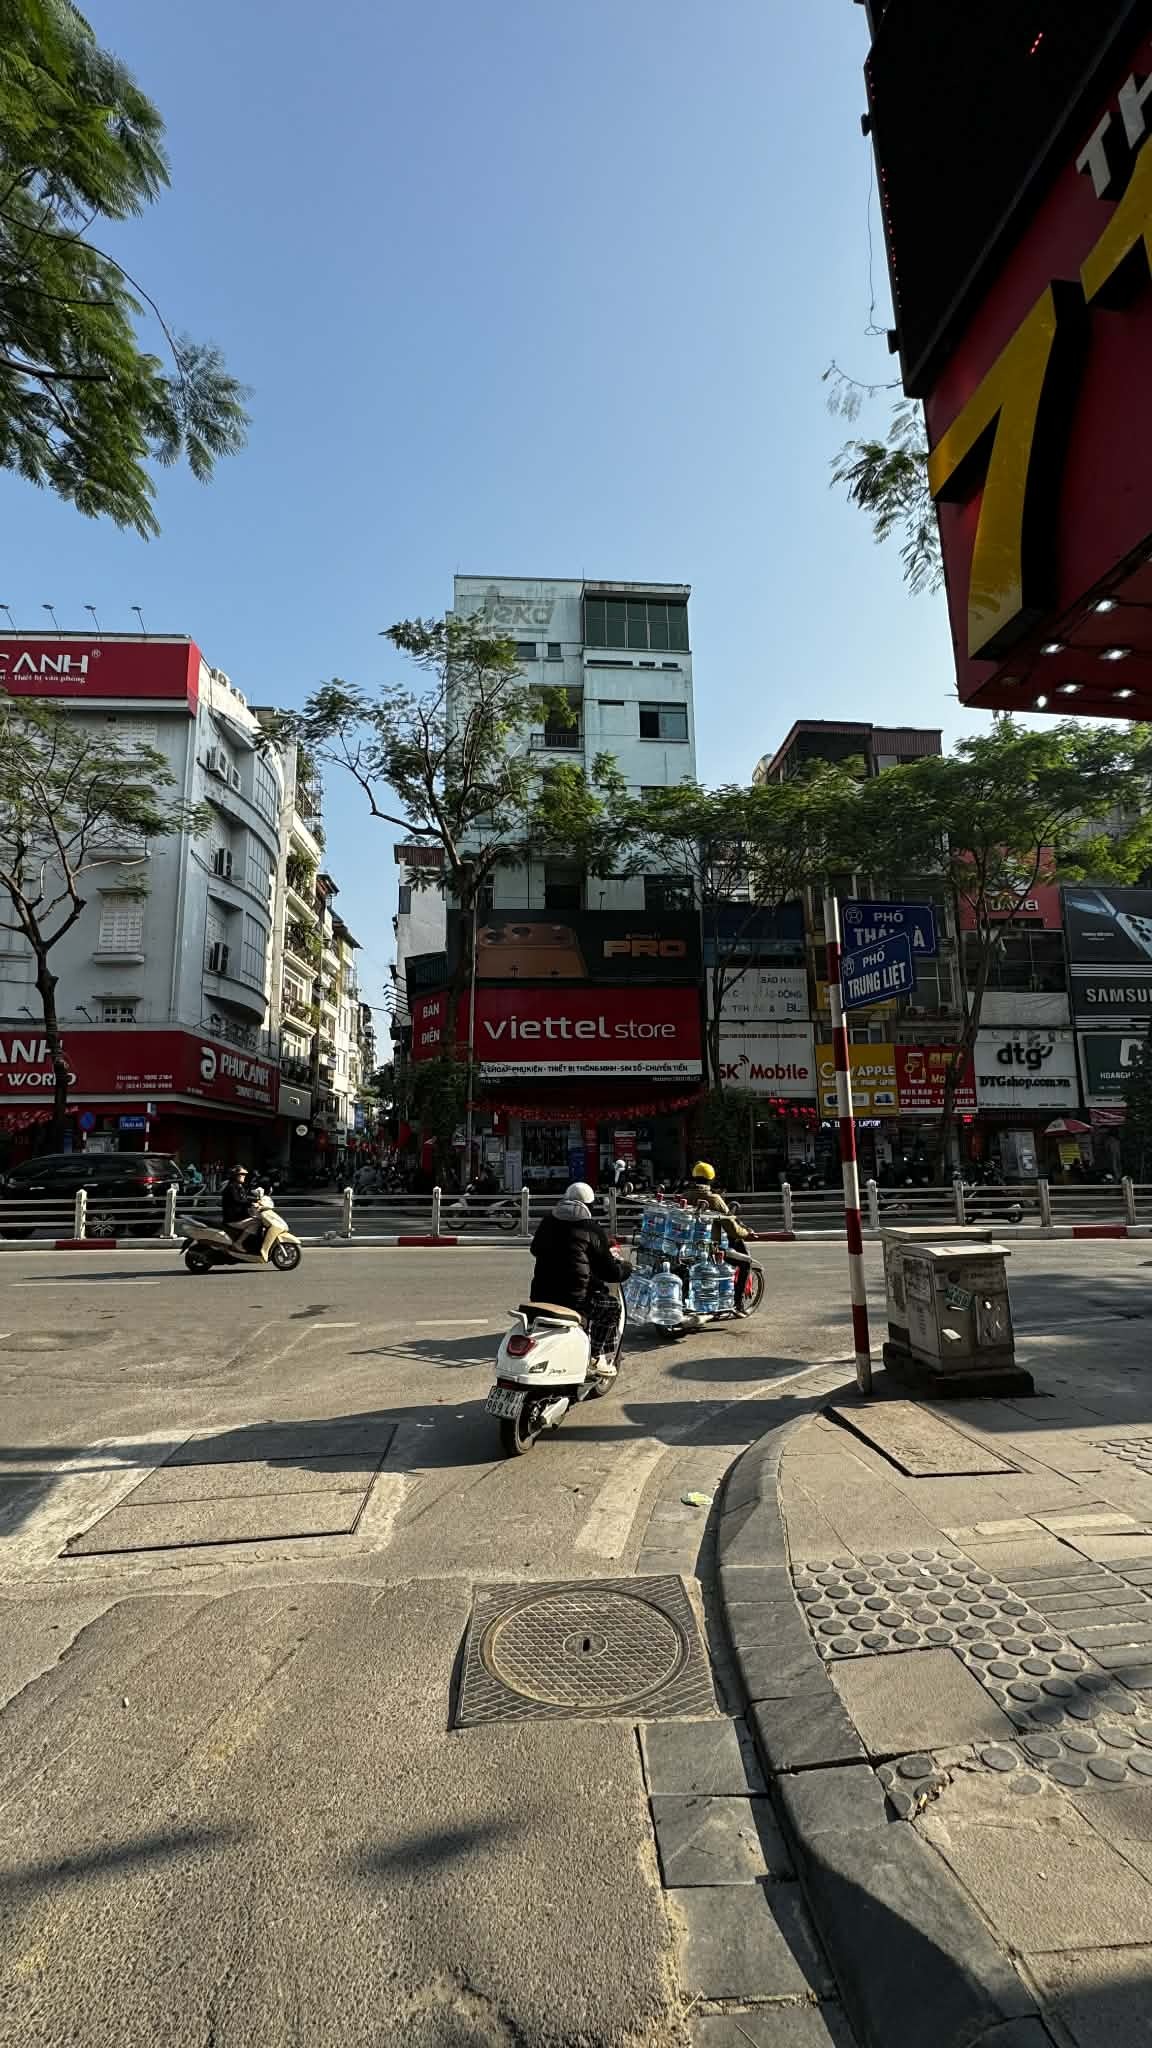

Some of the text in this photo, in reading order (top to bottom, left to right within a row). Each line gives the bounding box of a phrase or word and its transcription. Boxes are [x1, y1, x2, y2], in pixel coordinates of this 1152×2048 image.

[989, 900, 1039, 911] UAWEI
[873, 909, 904, 922] PHỐ
[853, 924, 896, 946] THÁ
[603, 940, 687, 958] PRO
[862, 945, 885, 968] PHỐ
[847, 971, 881, 999] TRUNG
[882, 960, 906, 989] LIỆT
[1086, 988, 1152, 1003] SAMSU
[483, 1016, 677, 1040] viettel store
[997, 1043, 1042, 1069] dtg
[750, 1064, 808, 1079] Mobile
[857, 1066, 895, 1076] APPLE
[8, 1073, 77, 1086] WORD
[979, 1076, 1071, 1089] DTGshop.com.vn
